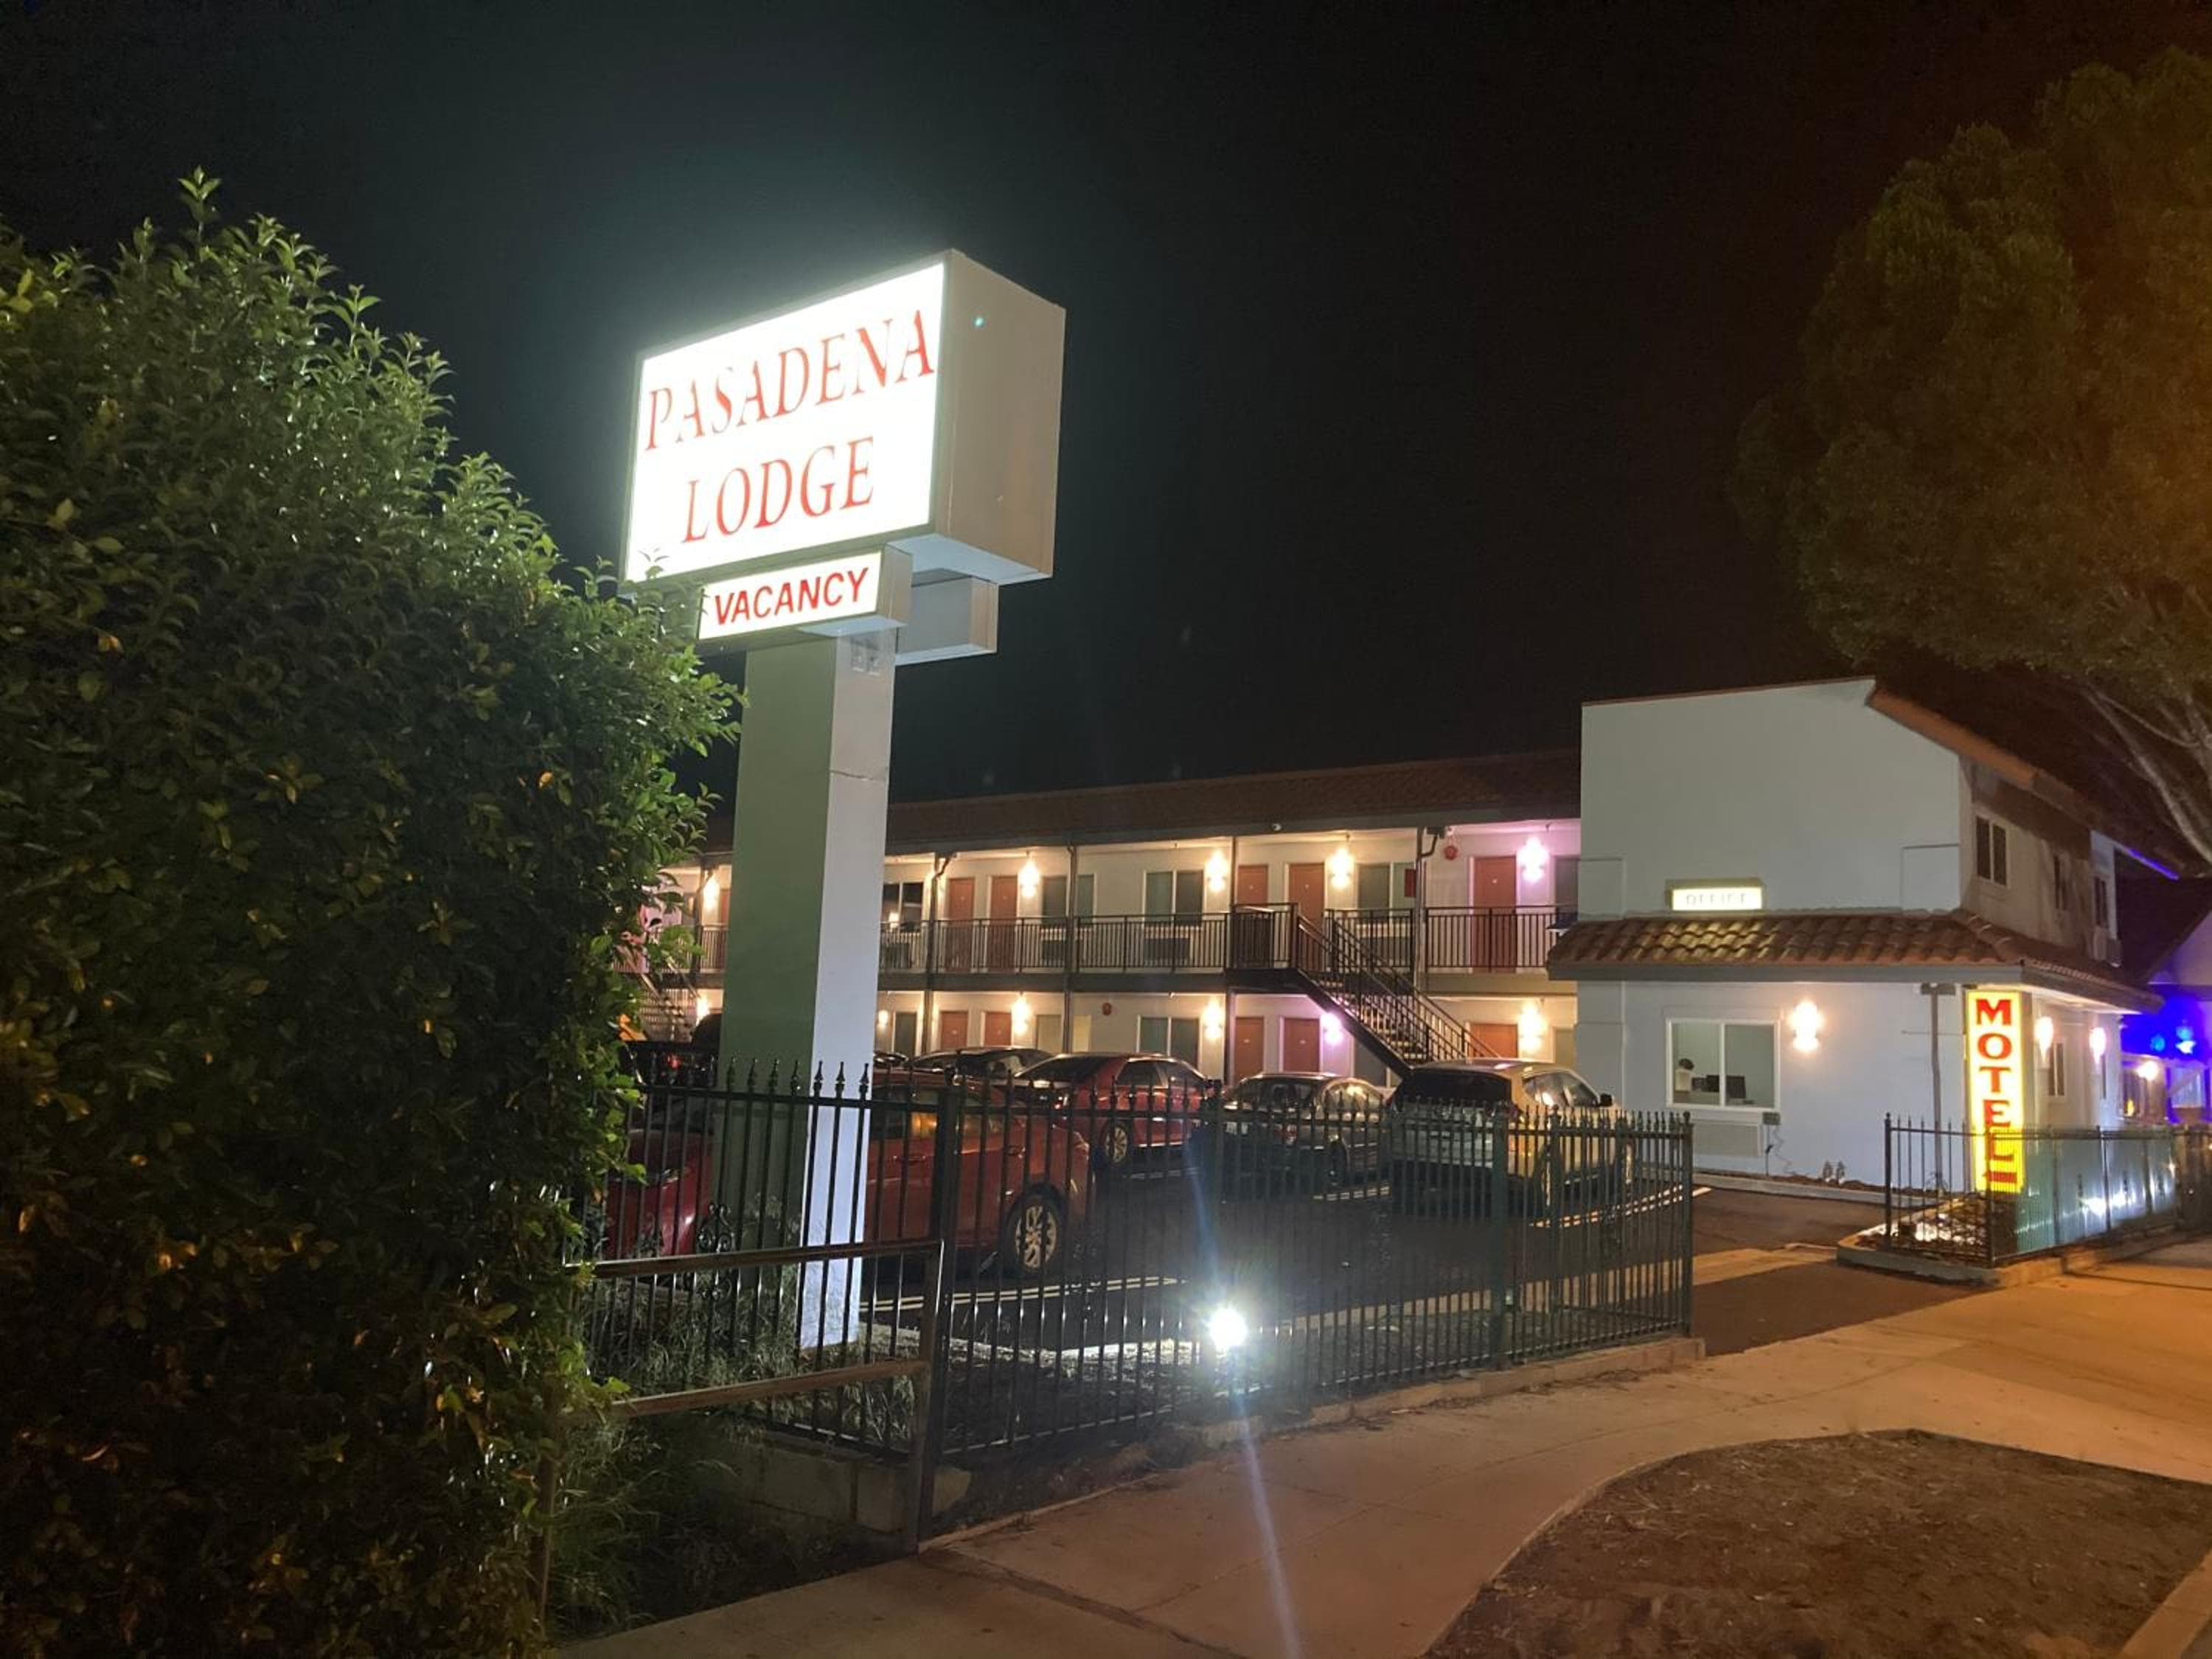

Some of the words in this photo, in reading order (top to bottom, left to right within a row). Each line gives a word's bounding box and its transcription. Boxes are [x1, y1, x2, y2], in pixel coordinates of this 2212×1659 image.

[646, 310, 934, 451] PASADENA
[681, 437, 874, 543] LODGE
[714, 567, 869, 626] VACANCY
[1975, 998, 2014, 1162] MOTEL
